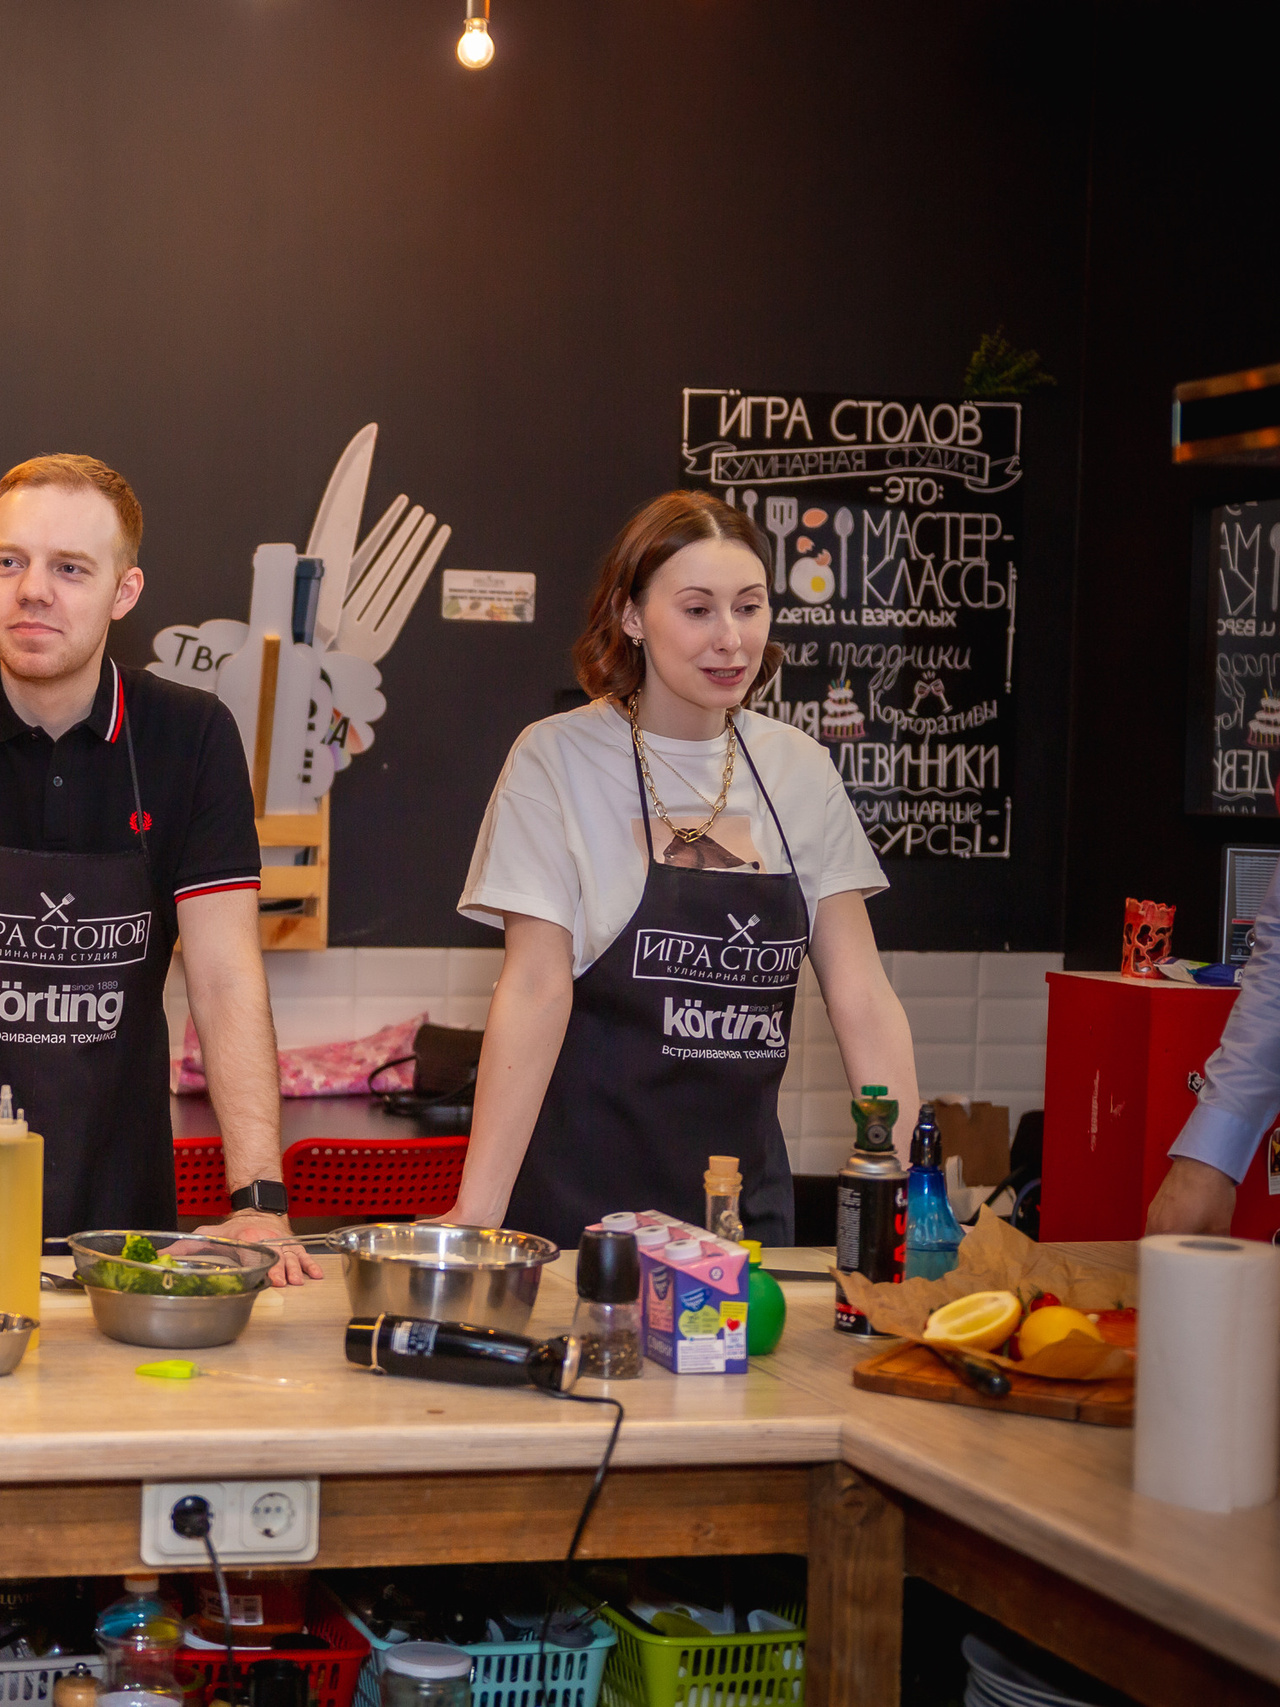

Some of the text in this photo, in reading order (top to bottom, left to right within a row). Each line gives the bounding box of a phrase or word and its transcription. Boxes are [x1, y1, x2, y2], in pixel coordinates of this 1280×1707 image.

[720, 395, 983, 446] ИГРА СТОЛОВ
[716, 447, 979, 480] КУЛИНАРНАЯ СТУДИЯ
[862, 508, 1015, 562] МАСТЕР-
[862, 556, 1013, 610] КЛАССЫ
[828, 640, 972, 691] праздники
[869, 687, 998, 745] Корпоративы
[838, 742, 1000, 789] ДЕВИЧНИКИ
[33, 918, 147, 950] СТОЛОВ
[70, 950, 118, 962] СТУДИЯ
[642, 935, 713, 969] ИГРА
[71, 980, 119, 992] since 1889
[666, 965, 790, 984] КУЛИНАРНАЯ СТУДИЯ
[70, 1030, 117, 1044] техника
[663, 996, 786, 1048] körting
[661, 1044, 787, 1061] встраиваемая техника
